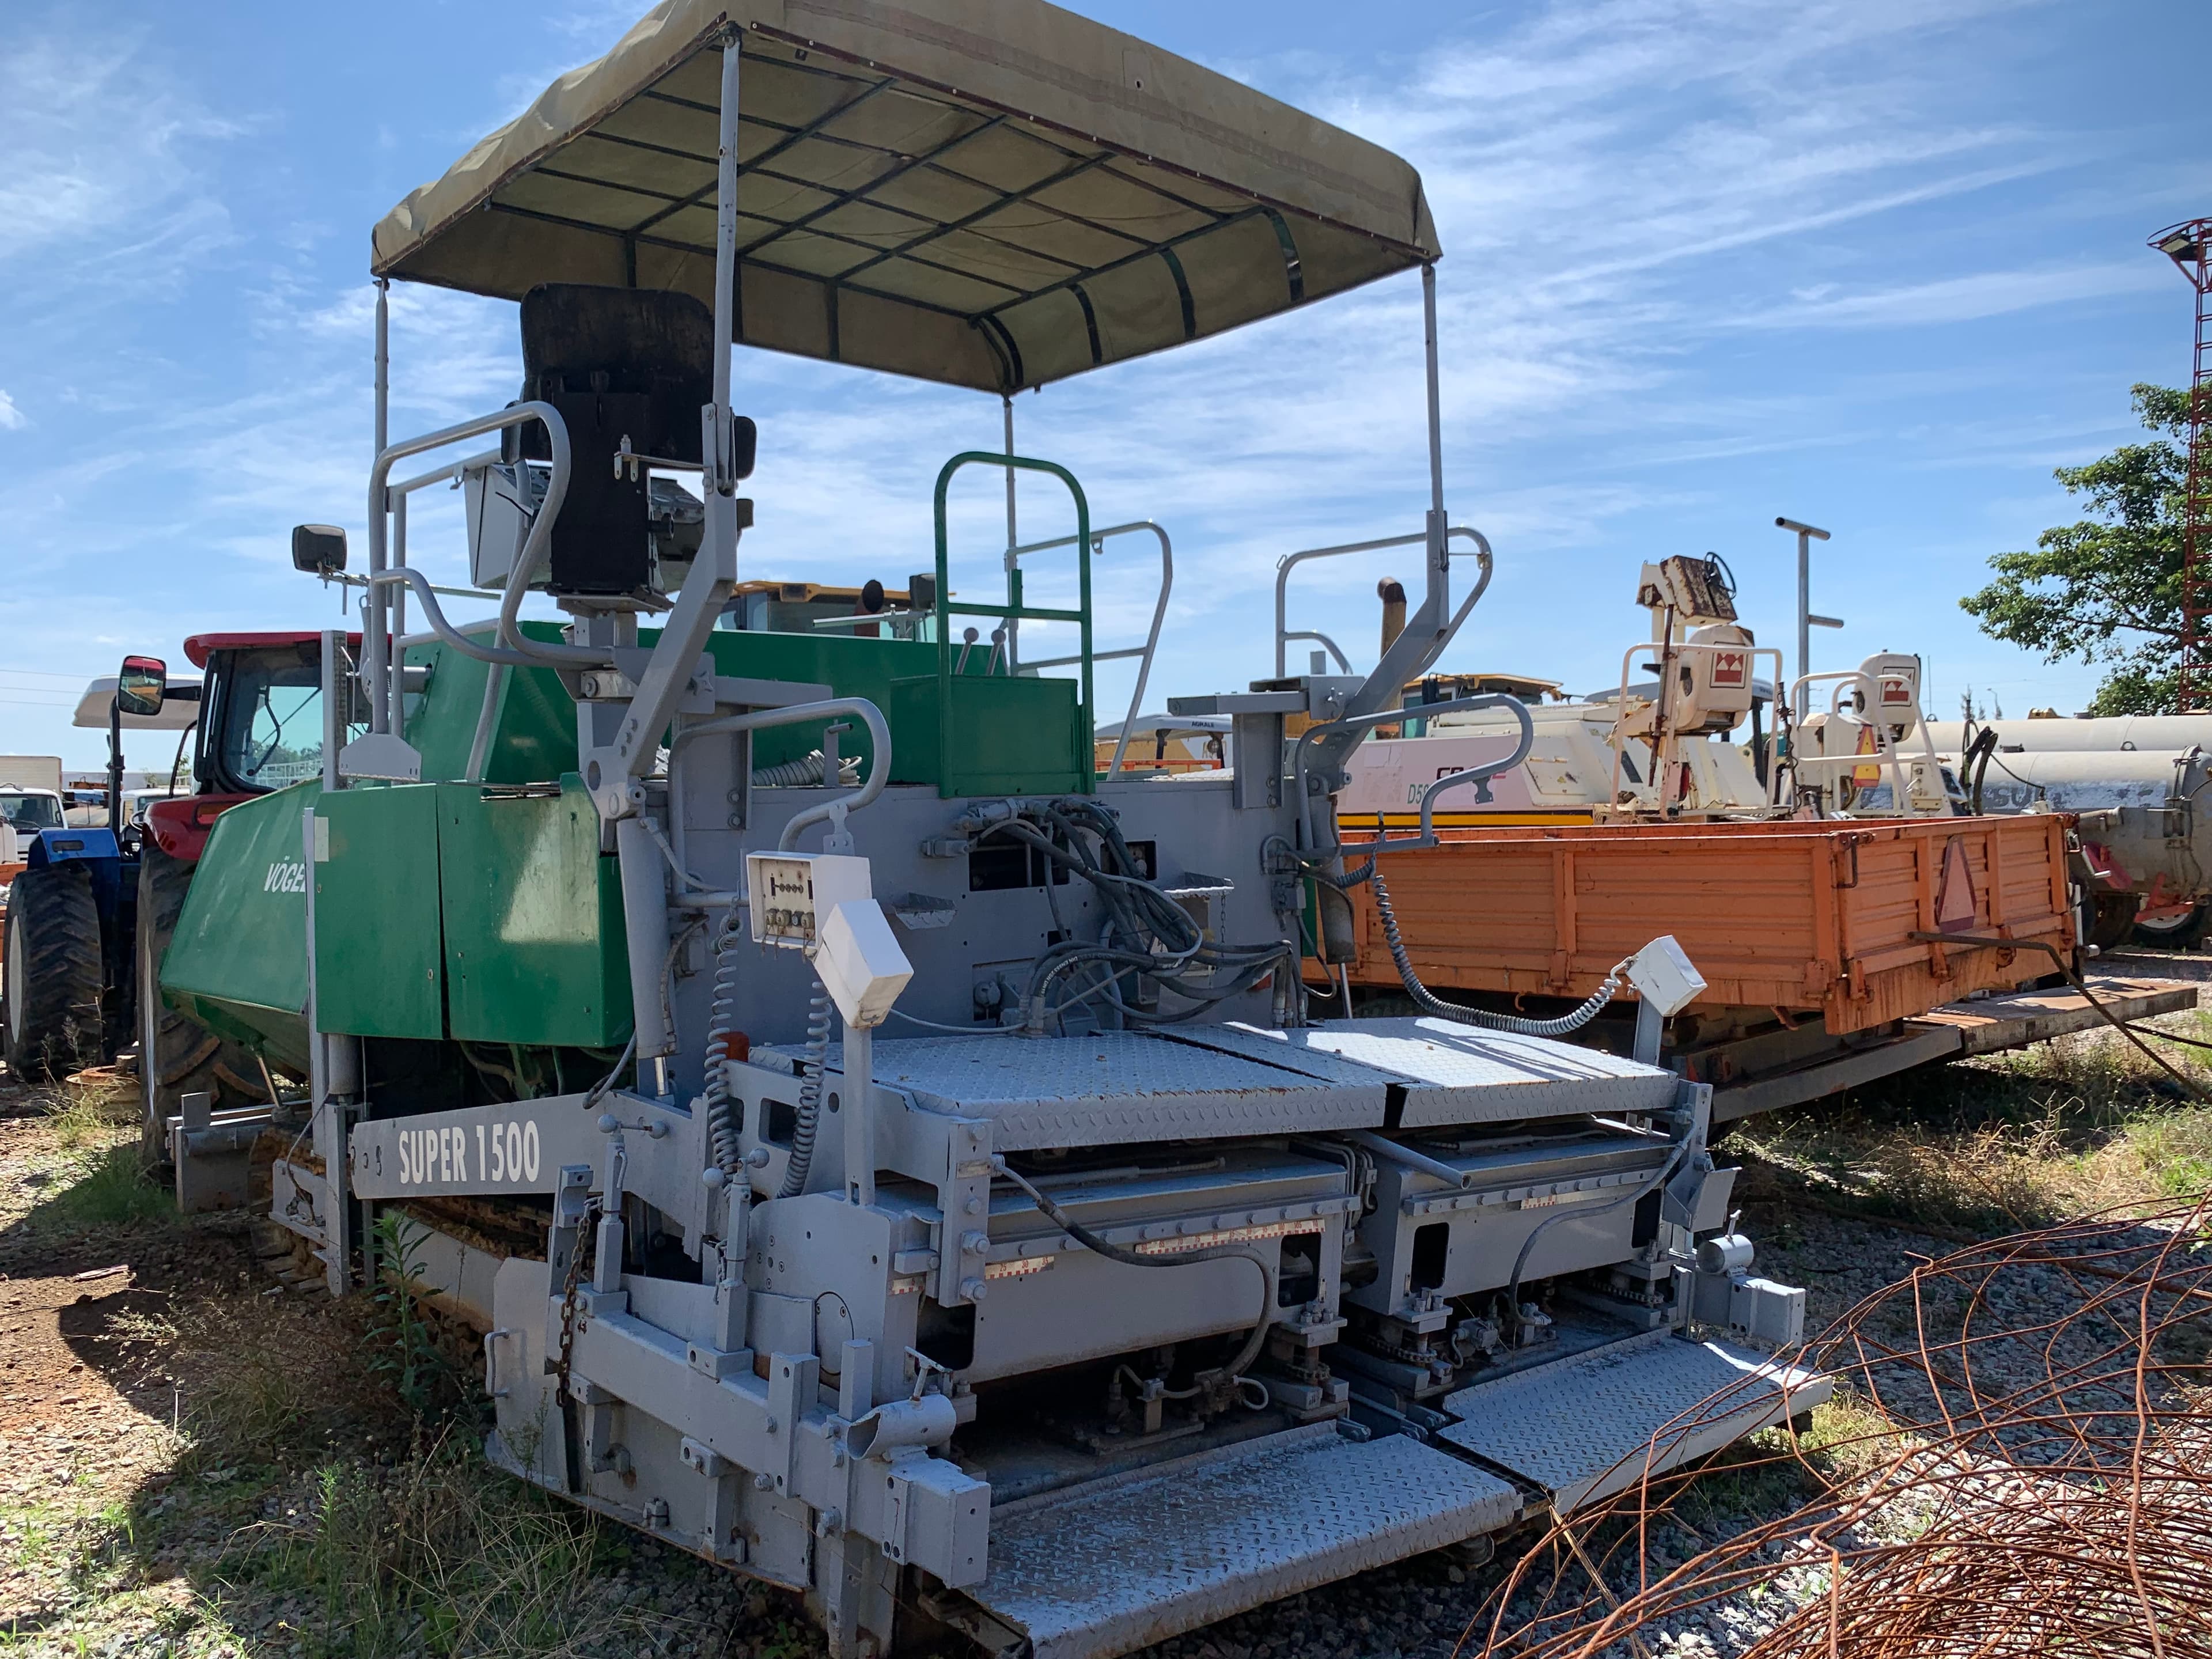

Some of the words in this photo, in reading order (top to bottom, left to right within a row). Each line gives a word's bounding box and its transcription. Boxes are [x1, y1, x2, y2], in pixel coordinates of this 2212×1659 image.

[399, 1127, 467, 1184] SUPER
[476, 1120, 540, 1182] 1500
[1000, 1263, 1007, 1272] 25
[1022, 1260, 1029, 1268] 30
[1042, 1256, 1048, 1266] 35
